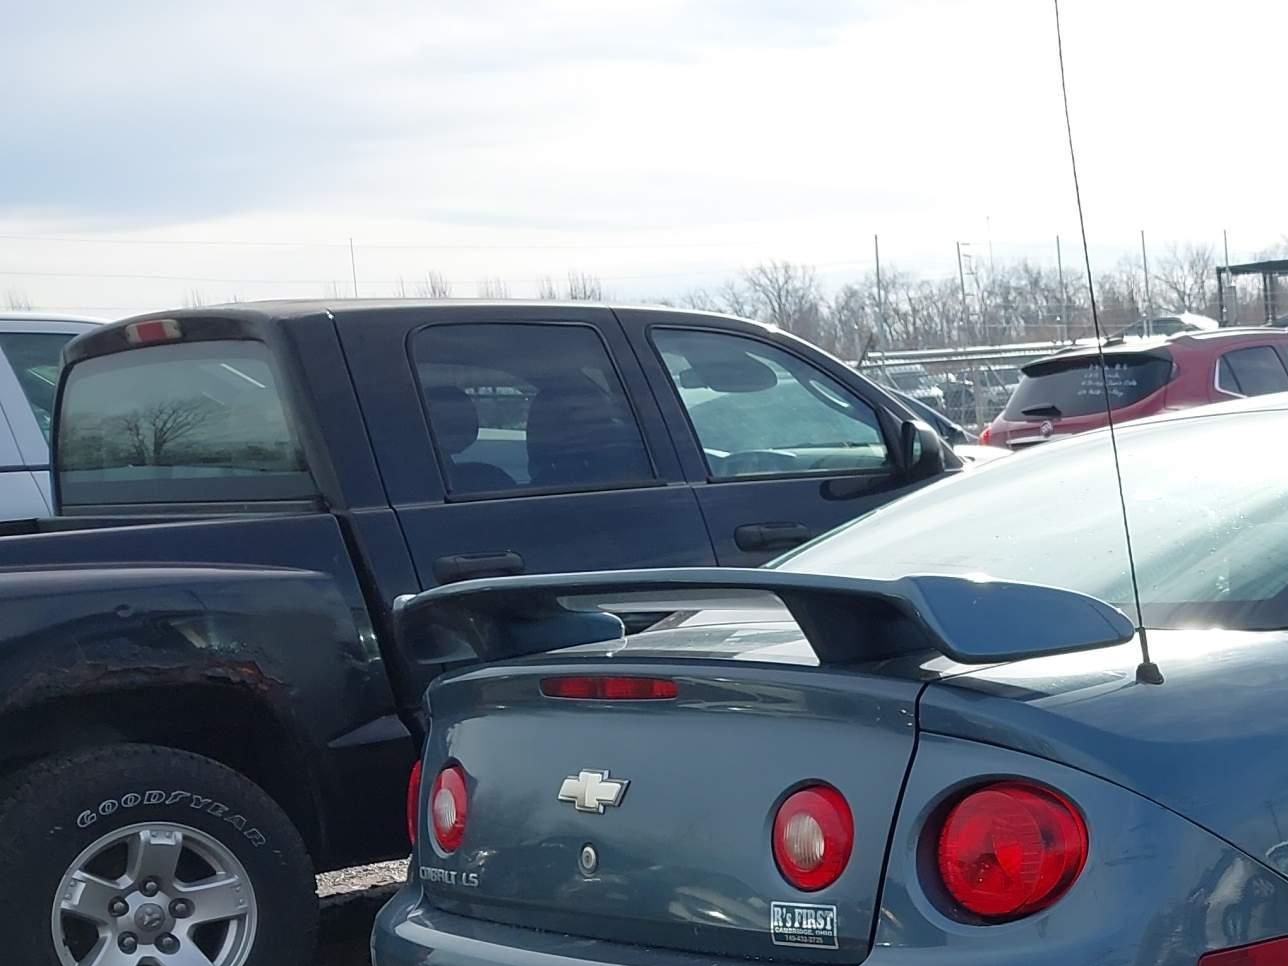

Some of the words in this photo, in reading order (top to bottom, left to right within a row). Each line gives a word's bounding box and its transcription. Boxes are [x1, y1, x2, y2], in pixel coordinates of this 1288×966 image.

[76, 790, 266, 847] GOODYEAR
[420, 866, 457, 885] COBALT
[462, 872, 479, 887] LS
[794, 909, 833, 930] FIRST
